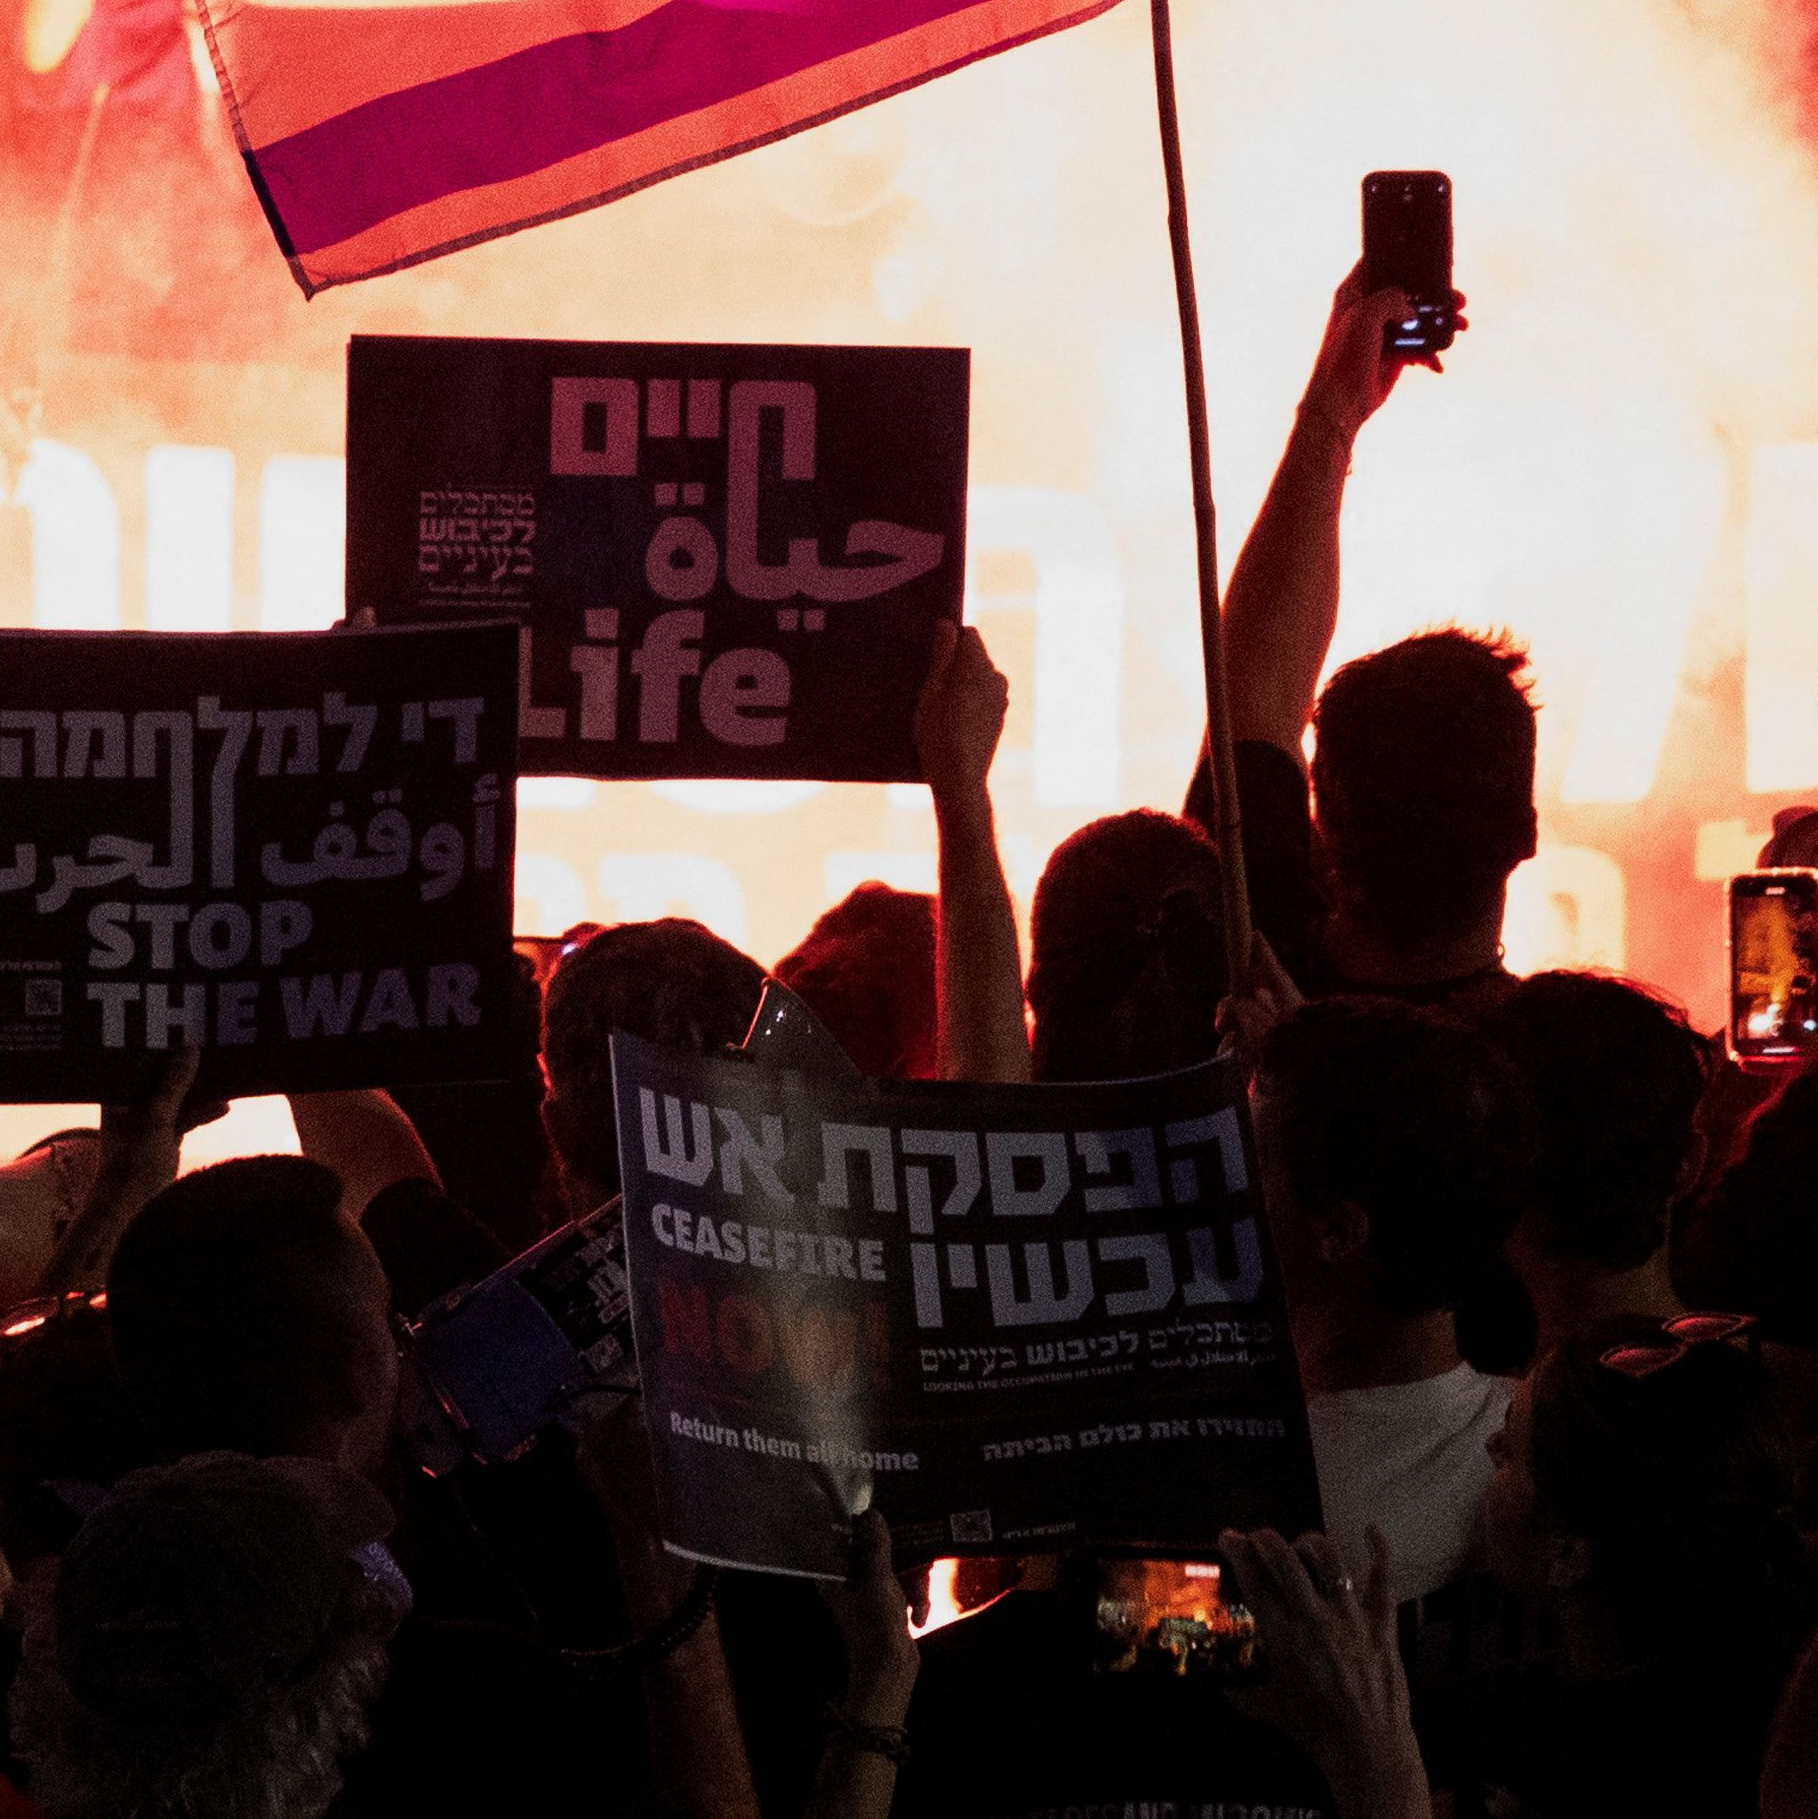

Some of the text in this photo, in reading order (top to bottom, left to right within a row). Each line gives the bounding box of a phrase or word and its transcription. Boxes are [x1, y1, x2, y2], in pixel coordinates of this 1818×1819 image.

[550, 377, 817, 522] חיים
[419, 482, 536, 515] מסתכלים
[419, 515, 536, 543] לכיבוש
[418, 545, 534, 582] בעיניים
[518, 608, 792, 747] Life
[401, 696, 485, 765] די
[86, 900, 314, 971] STOP
[85, 962, 483, 1050] THE WAR
[638, 1087, 1250, 1235] הפסקת אש
[651, 1203, 888, 1283] CEASEFIRE
[908, 1216, 1266, 1329] עכשיו
[919, 1345, 1019, 1377] בעיניים
[1025, 1329, 1140, 1367] לכיבוש
[670, 1410, 739, 1449] Return
[742, 1426, 802, 1461] them
[981, 1432, 1073, 1463] הביתה
[1079, 1422, 1143, 1449] כולם
[1148, 1417, 1191, 1440] את
